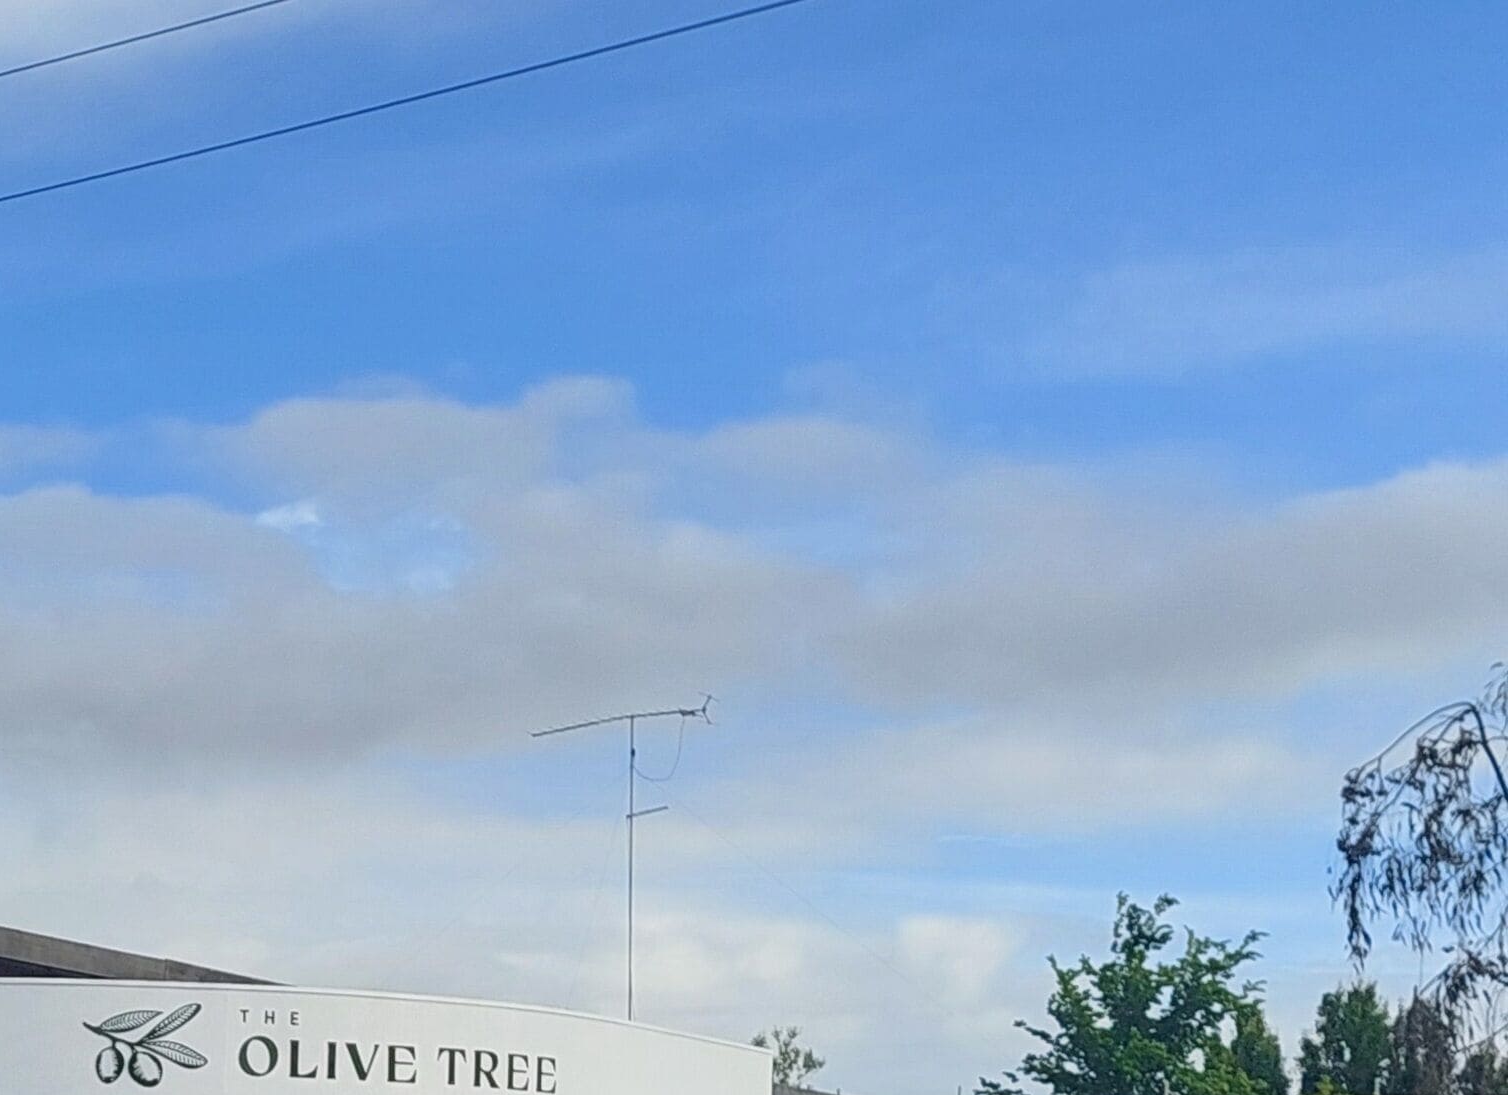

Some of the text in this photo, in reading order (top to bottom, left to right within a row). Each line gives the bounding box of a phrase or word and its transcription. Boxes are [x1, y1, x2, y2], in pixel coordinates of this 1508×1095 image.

[239, 1008, 300, 1026] THE
[238, 1035, 557, 1095] OLIVE TREE
